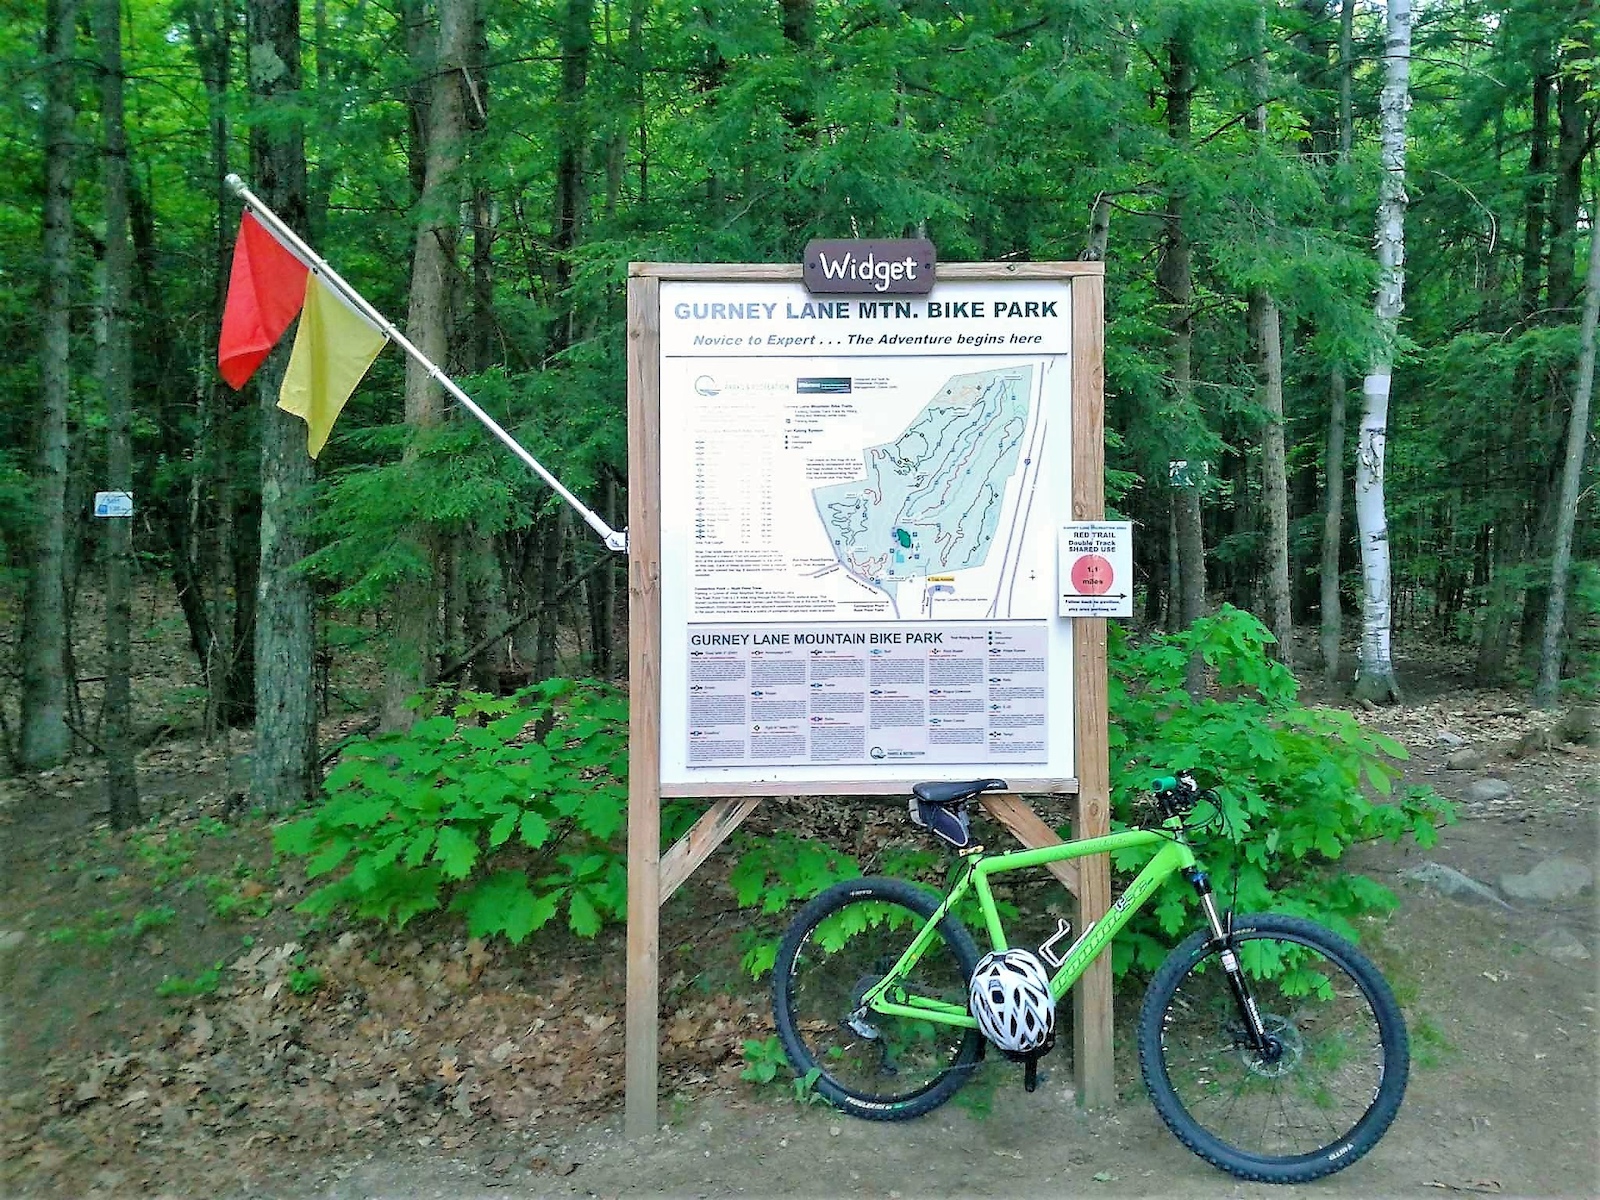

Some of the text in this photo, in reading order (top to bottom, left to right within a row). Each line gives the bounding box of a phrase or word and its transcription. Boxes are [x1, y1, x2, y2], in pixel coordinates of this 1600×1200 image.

[819, 252, 918, 292] Widget
[674, 301, 1058, 319] GURNEY LANE MTN. BIKE PARK
[693, 334, 743, 346] Novice
[748, 335, 762, 346] to
[766, 334, 816, 347] Expert
[847, 334, 874, 345] The
[878, 334, 952, 345] Adventure
[956, 334, 1005, 347] begins
[1009, 333, 1042, 344] here
[691, 634, 750, 646] GURNEY
[753, 634, 790, 645] LANE
[794, 633, 866, 645] MOUNTAIN
[869, 633, 902, 644] BIKE
[905, 632, 943, 644] PARK
